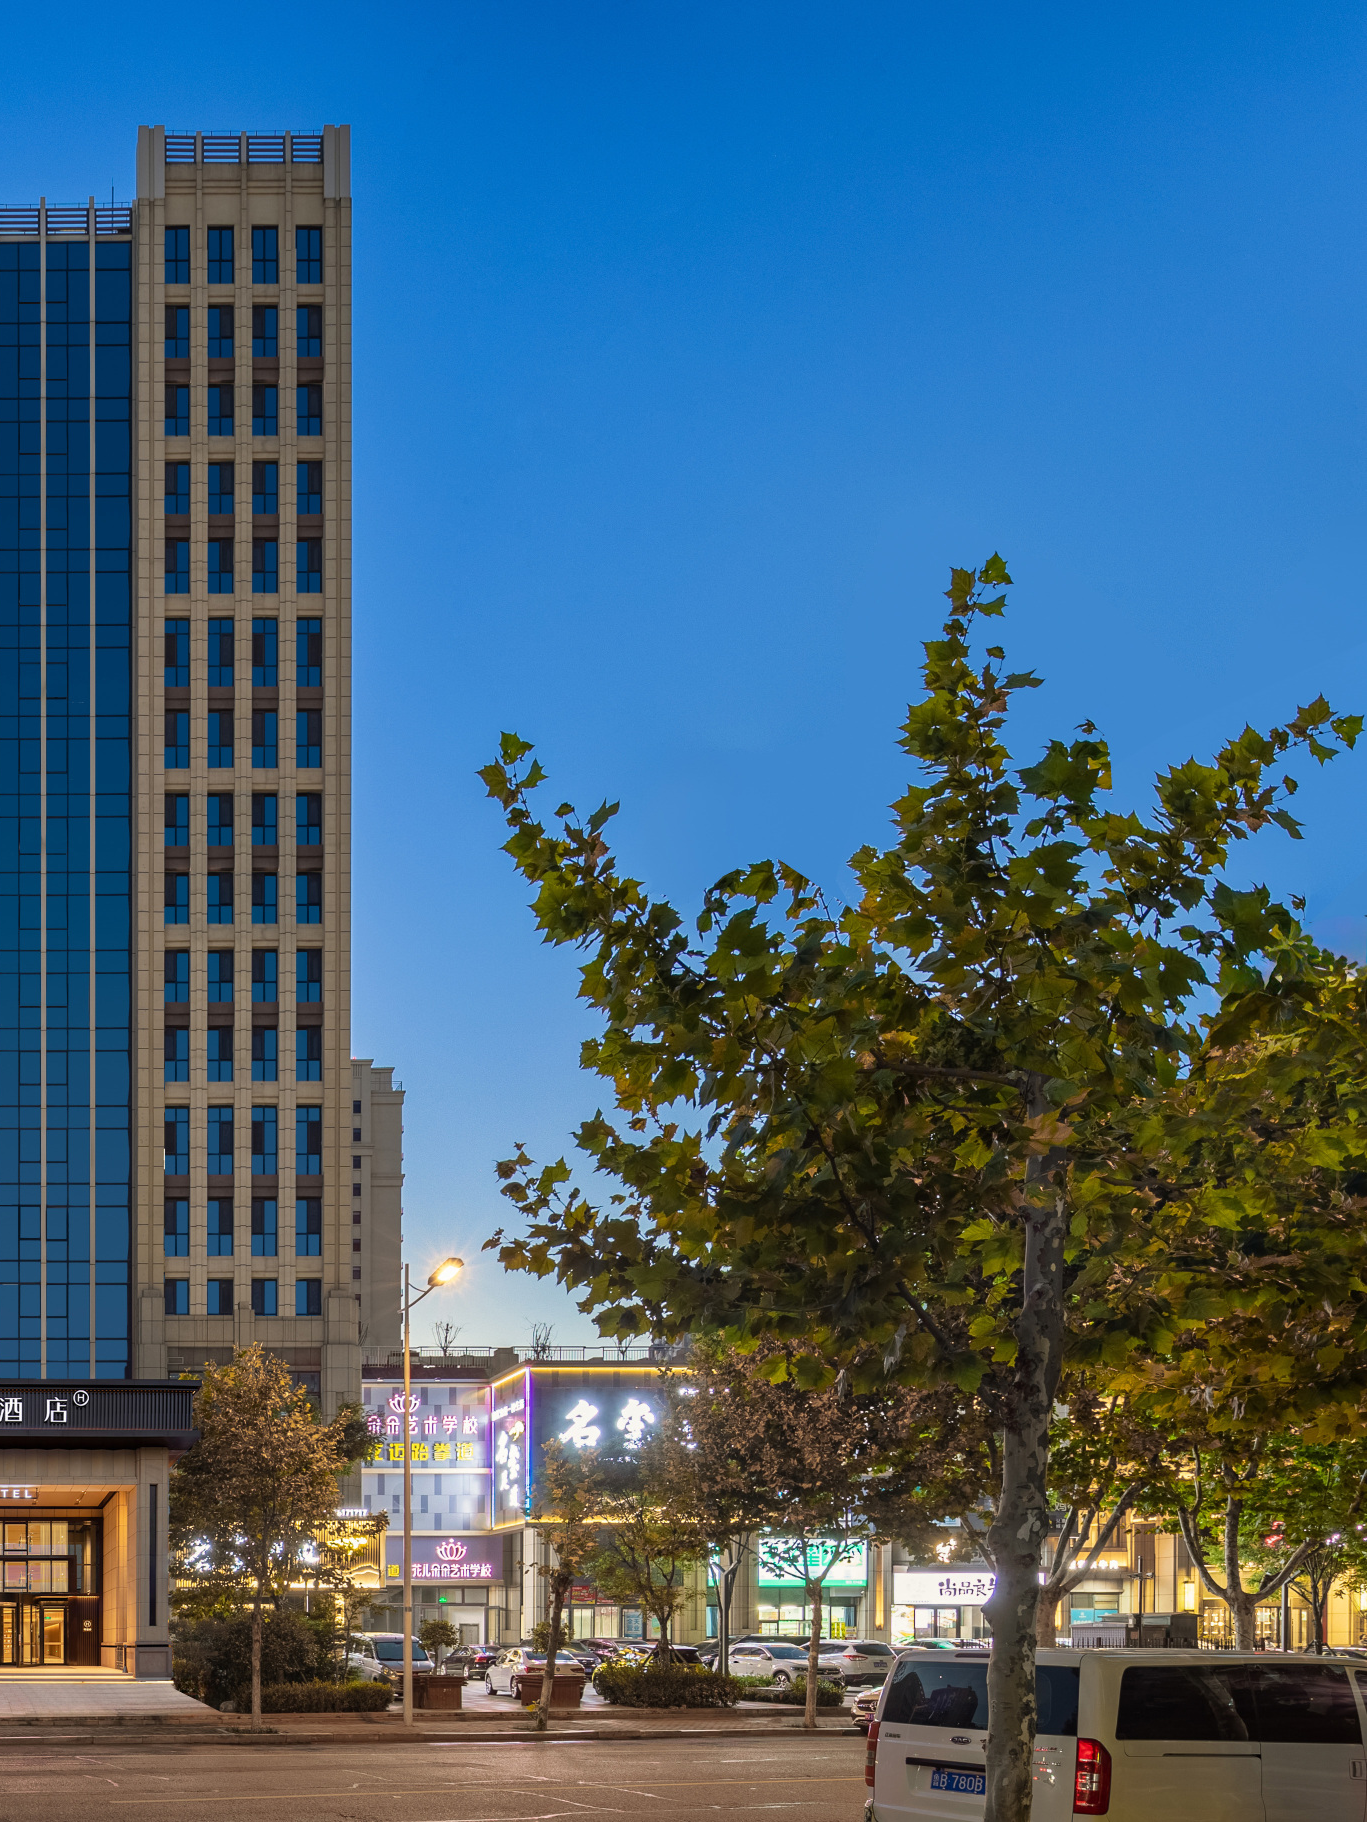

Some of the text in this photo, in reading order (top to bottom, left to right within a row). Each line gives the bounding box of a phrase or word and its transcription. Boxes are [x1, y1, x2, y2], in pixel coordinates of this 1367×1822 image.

[412, 1564, 491, 1578] 花儿朵朵艺术学校
